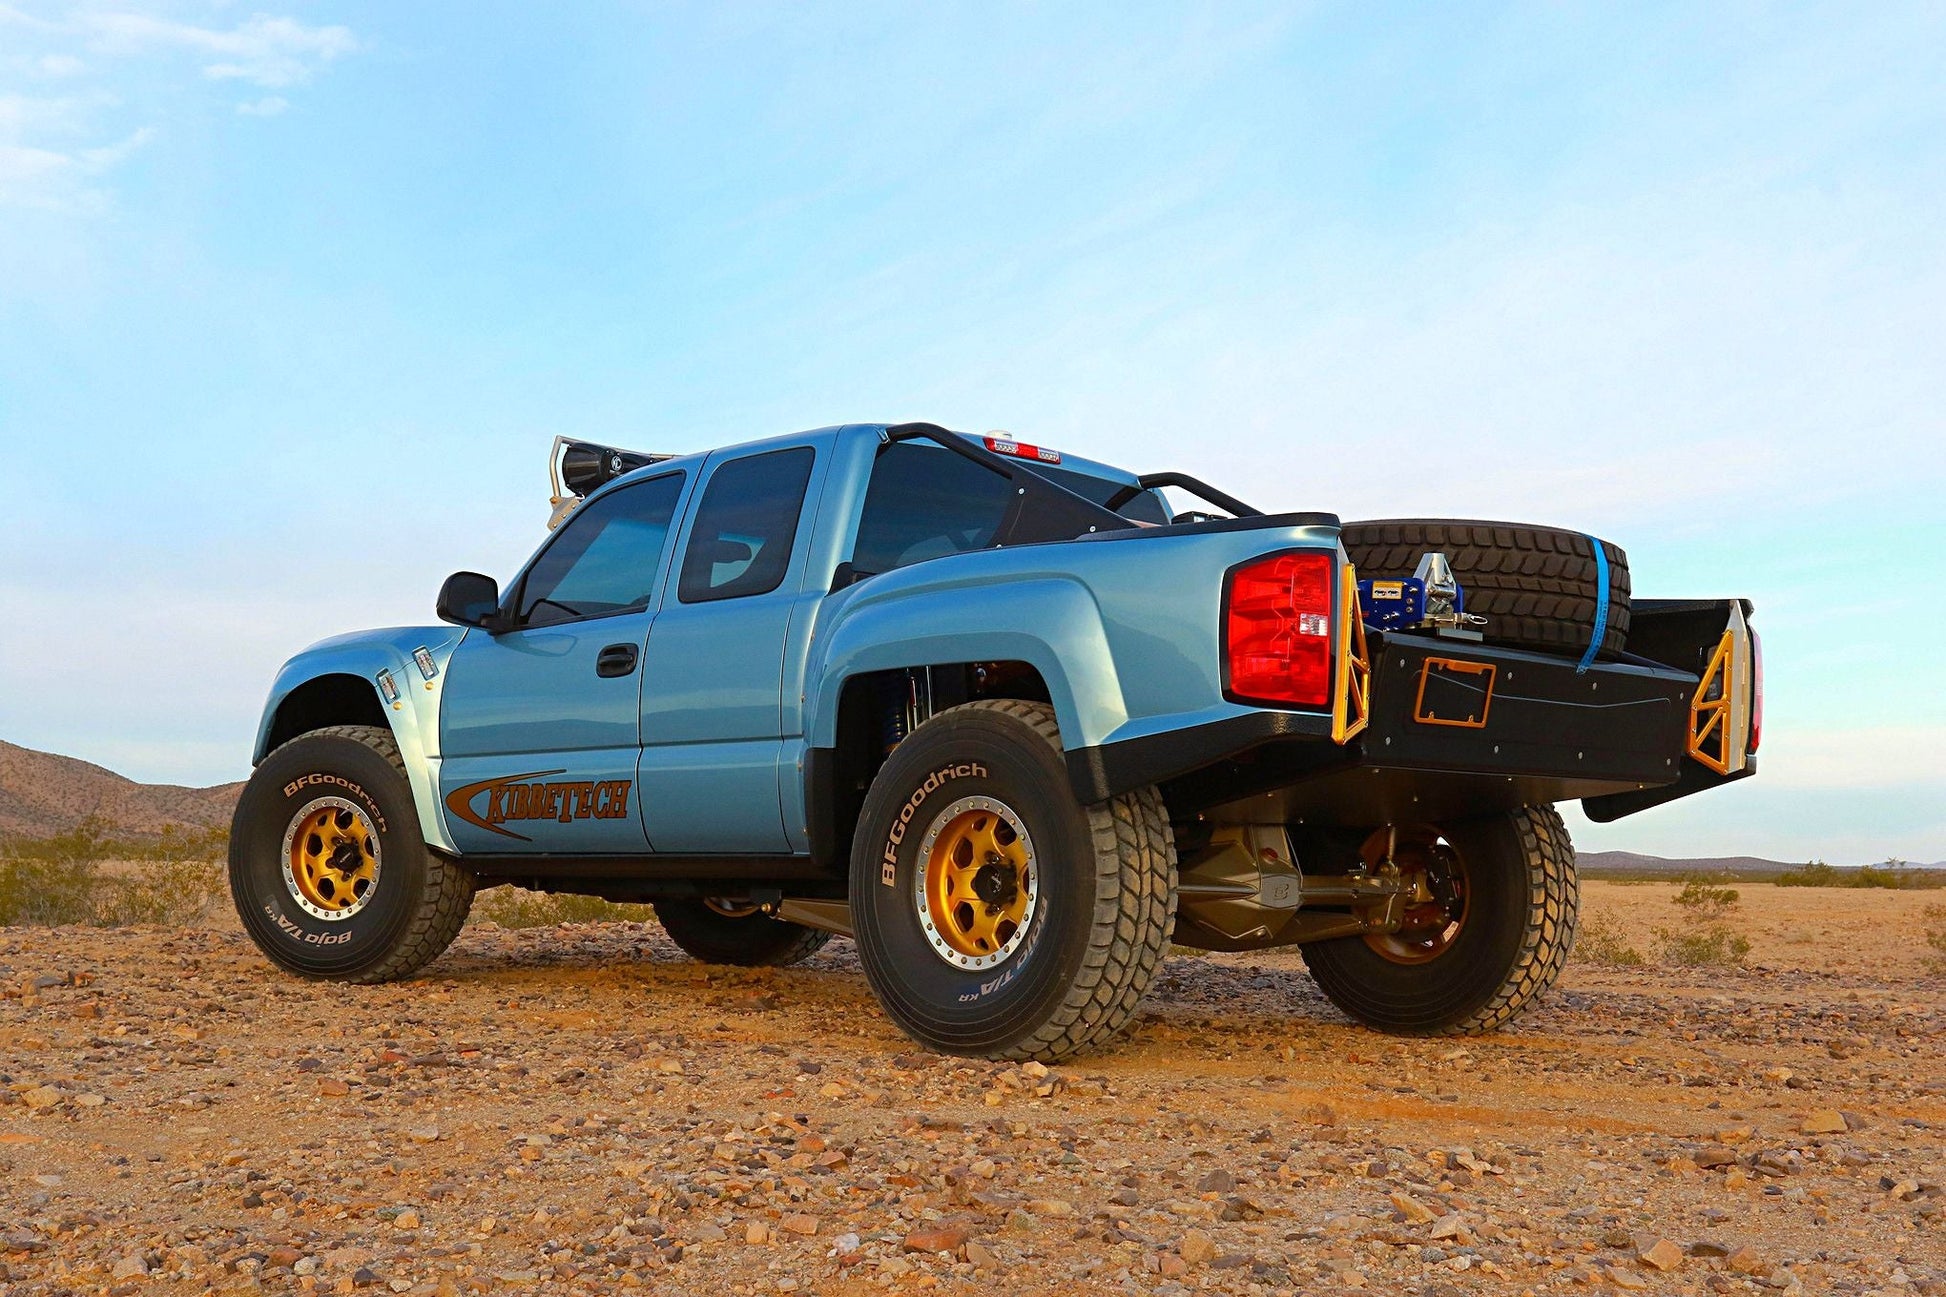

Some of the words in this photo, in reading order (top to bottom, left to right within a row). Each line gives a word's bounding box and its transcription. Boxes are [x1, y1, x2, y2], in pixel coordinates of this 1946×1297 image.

[283, 773, 388, 833] BFGoodrich
[881, 761, 988, 888] BFGoodrich
[277, 913, 304, 941] T/A
[304, 930, 352, 948] Baja
